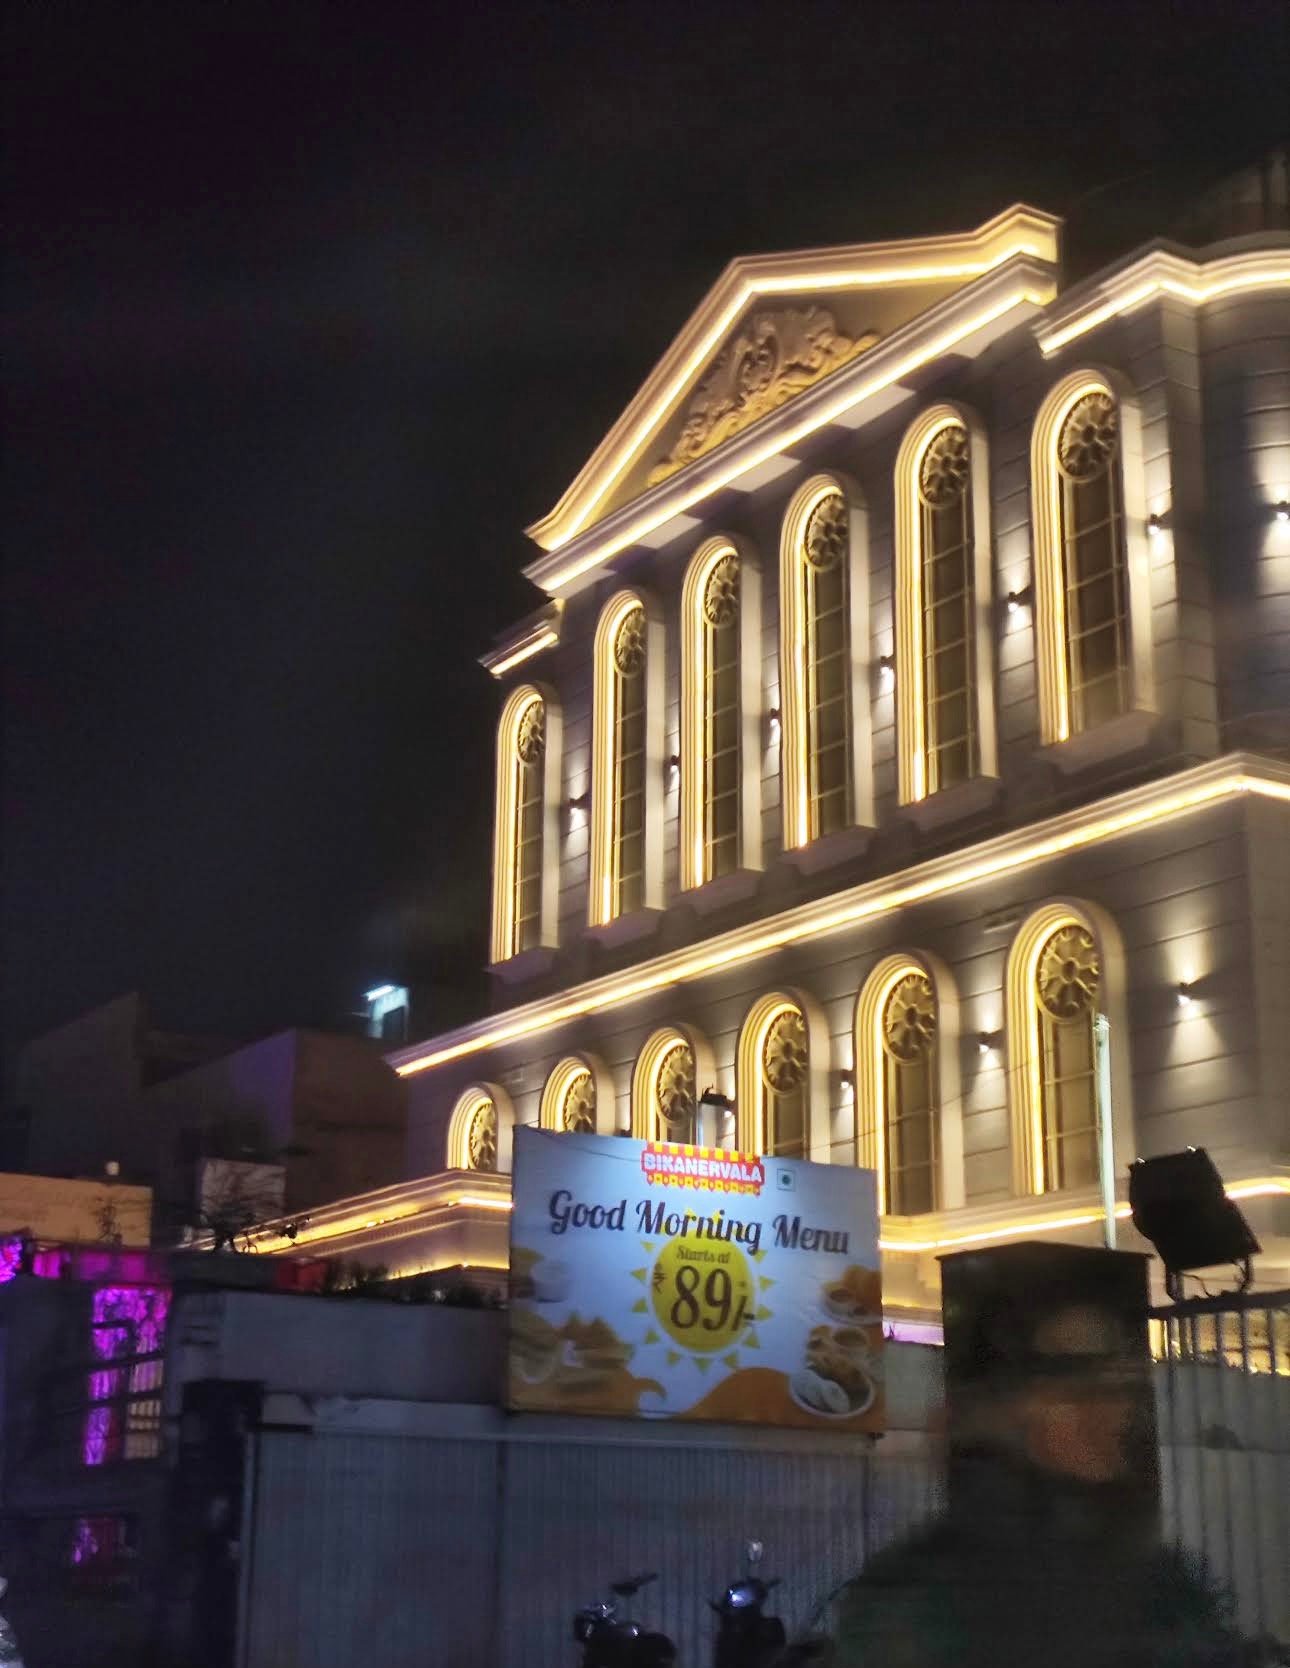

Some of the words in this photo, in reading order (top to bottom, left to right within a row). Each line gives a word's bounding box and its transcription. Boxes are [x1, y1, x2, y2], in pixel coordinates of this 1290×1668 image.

[643, 1153, 763, 1183] BIKANERVALA
[549, 1190, 626, 1235] Good
[636, 1200, 763, 1256] Morning
[773, 1214, 849, 1255] Menu
[676, 1245, 714, 1262] Starts
